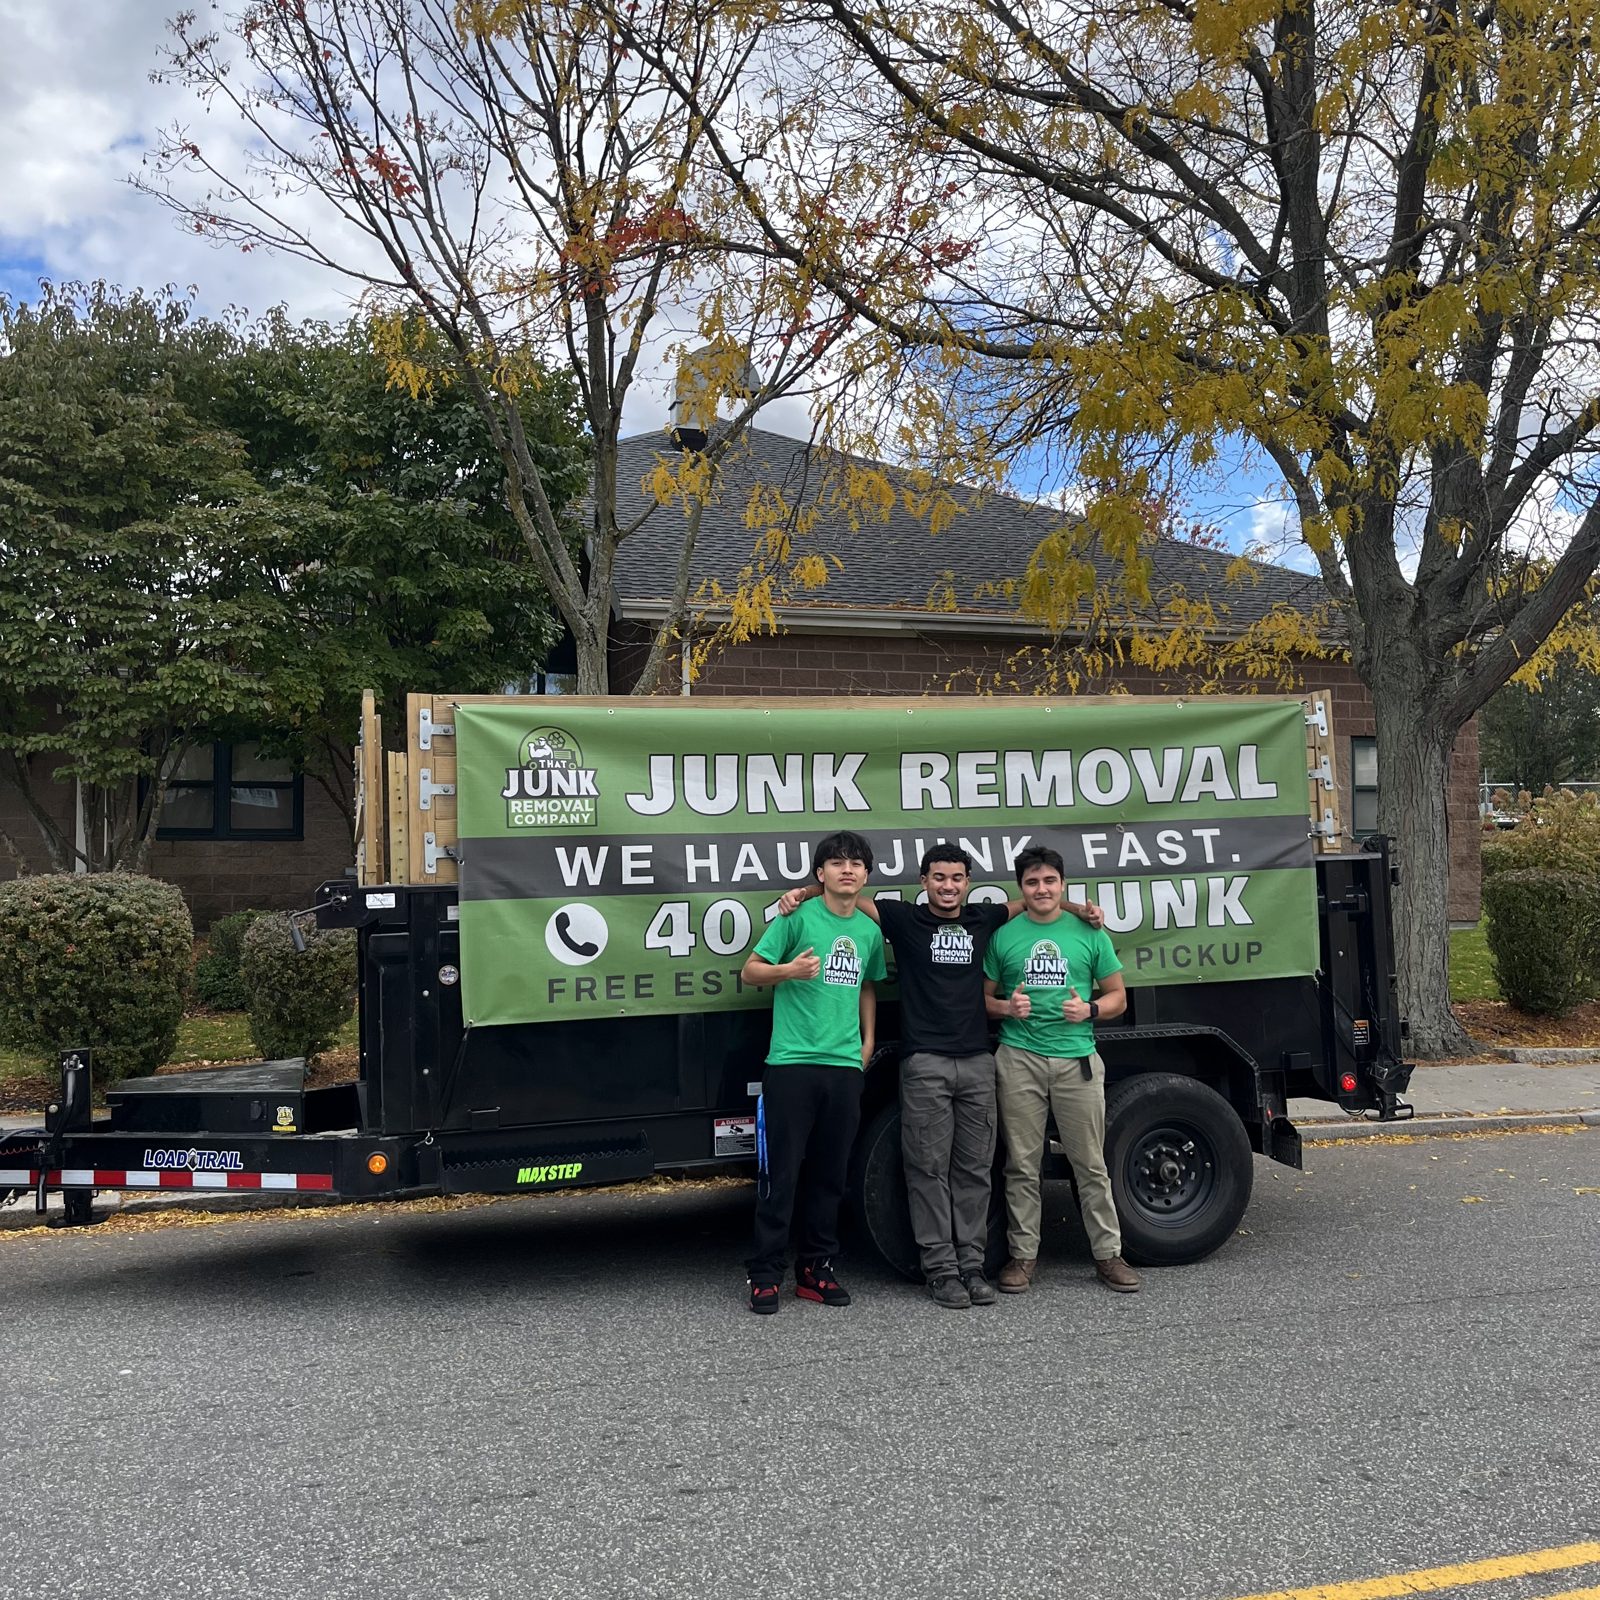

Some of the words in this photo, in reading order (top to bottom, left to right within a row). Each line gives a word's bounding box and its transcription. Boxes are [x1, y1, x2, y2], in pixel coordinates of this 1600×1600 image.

[538, 759, 567, 769] THAT
[502, 769, 599, 798] JUNK
[625, 753, 872, 816] JUNK
[900, 744, 1278, 811] REMOVAL
[511, 799, 594, 813] REMOVAL
[514, 813, 590, 825] COMPANY
[554, 844, 655, 887] WE
[685, 841, 811, 884] HAU
[1081, 827, 1241, 868] FAST.
[644, 896, 783, 958] 40
[932, 935, 972, 950] JUNK
[934, 949, 969, 957] REMOVAL
[825, 955, 861, 972] JUNK
[1025, 959, 1066, 973] JUNK
[548, 973, 655, 1004] FREE
[1135, 941, 1263, 970] PICKUP
[825, 969, 857, 980] REMOVAL
[825, 976, 856, 985] COMPANY
[143, 1149, 189, 1168] LOAD
[195, 1150, 244, 1170] TRAIL
[516, 1162, 582, 1184] MAXSTEP
